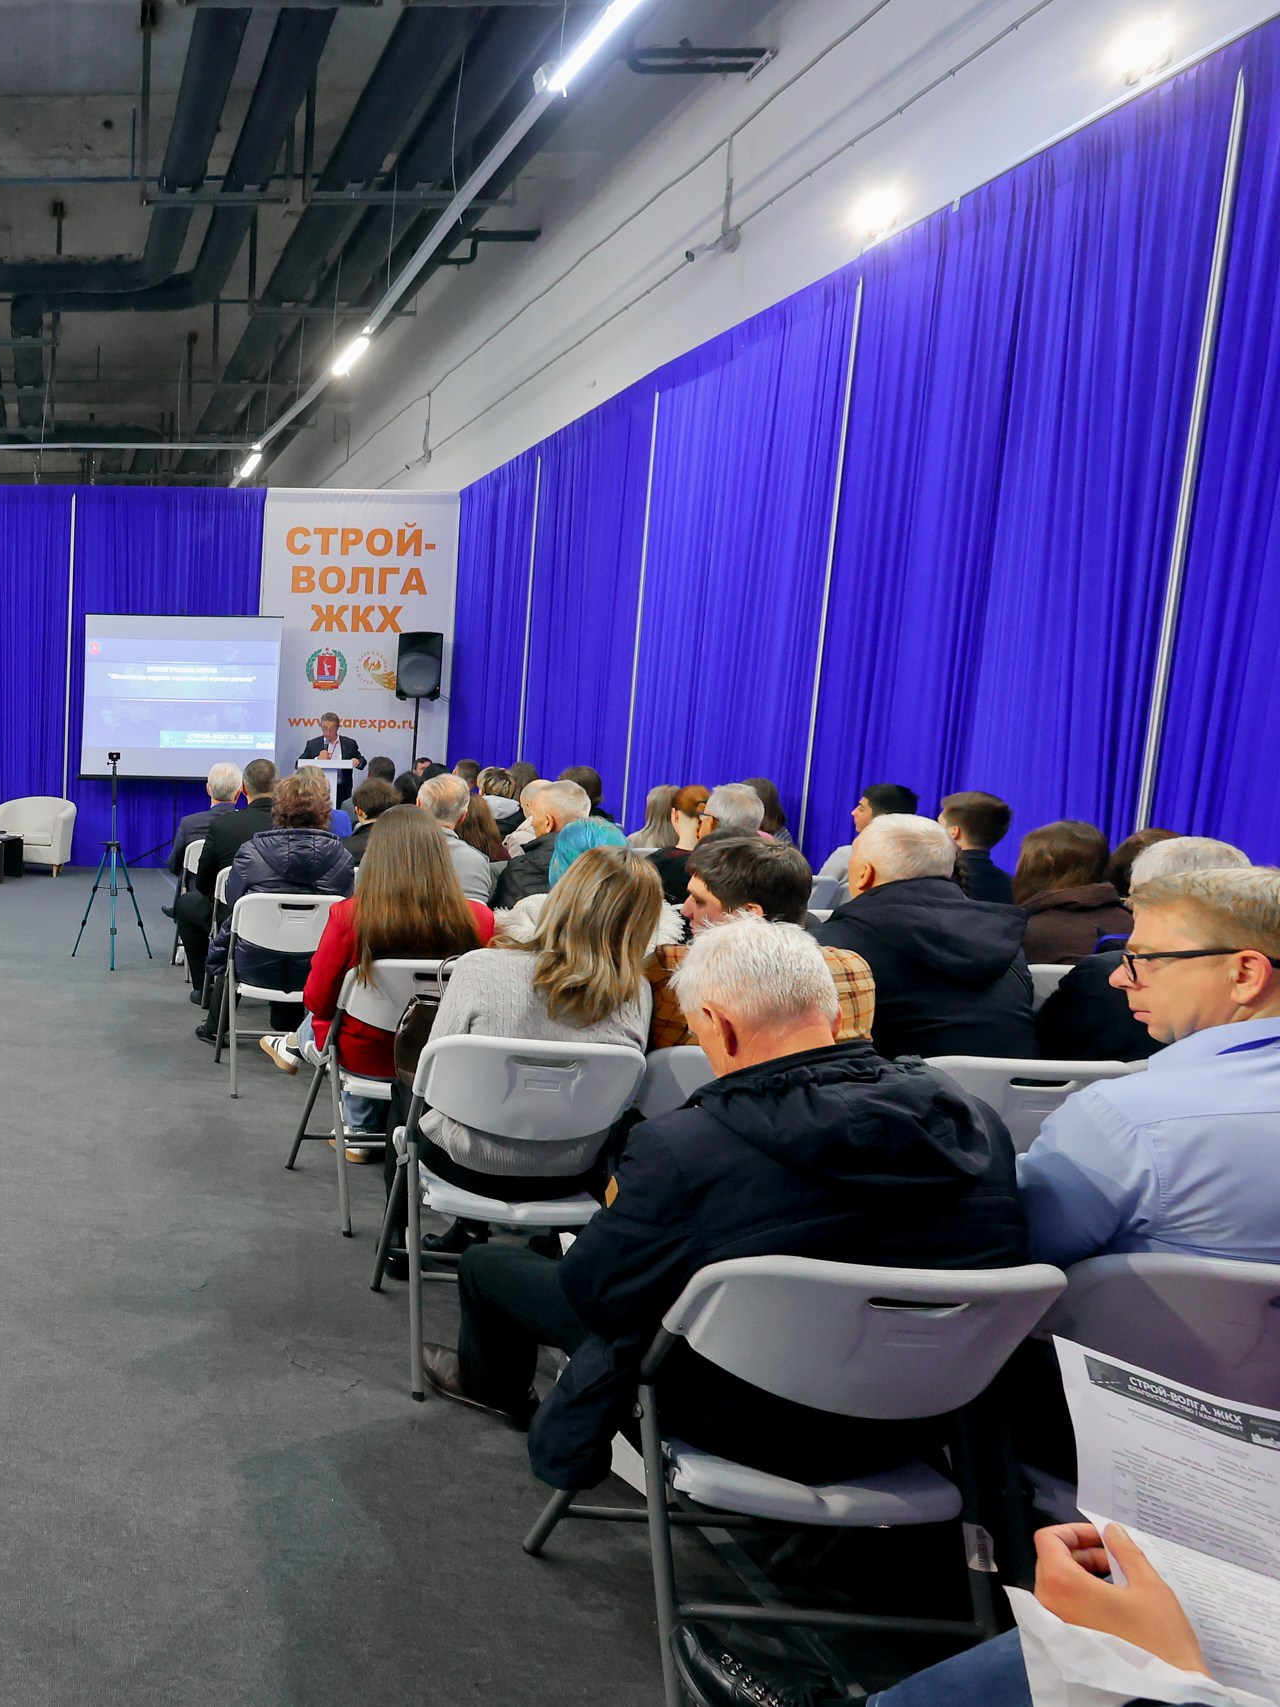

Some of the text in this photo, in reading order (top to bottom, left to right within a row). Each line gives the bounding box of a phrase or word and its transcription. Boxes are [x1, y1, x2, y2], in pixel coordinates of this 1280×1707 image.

[286, 522, 437, 557] СТРОЙ-
[291, 565, 427, 595] ВОЛГА
[310, 604, 403, 633] ЖКХ
[1129, 1376, 1242, 1425] СТРОЙ-ВОЛГА. ЖКХ
